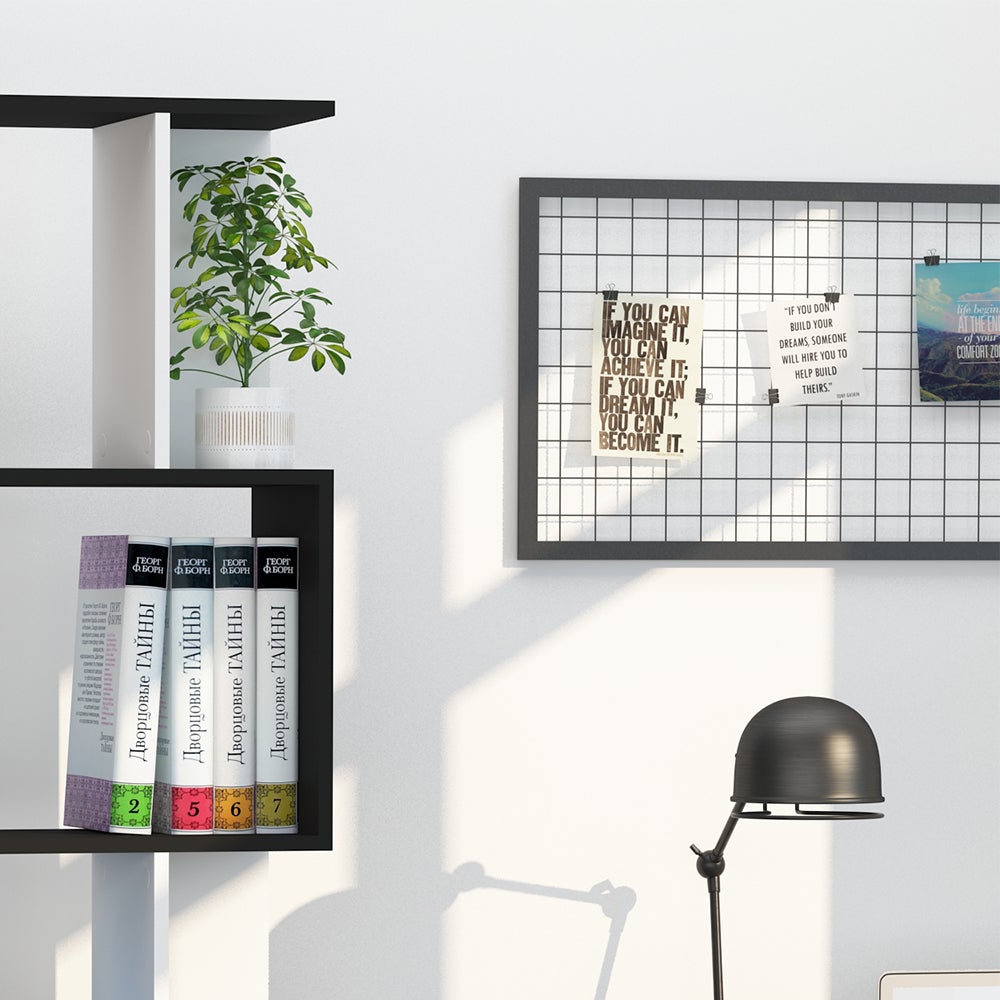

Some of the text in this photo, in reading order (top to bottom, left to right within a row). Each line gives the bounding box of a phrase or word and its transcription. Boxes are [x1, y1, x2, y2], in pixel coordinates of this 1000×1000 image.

[602, 301, 689, 324] IF YOU CAN
[797, 304, 812, 315] YOU
[957, 304, 971, 315] life
[790, 318, 833, 332] BUILD YOUR
[957, 315, 985, 333] AT THE
[602, 320, 689, 345] IMAGINE IT,
[964, 333, 997, 345] of your
[602, 338, 668, 360] YOU CAN
[779, 333, 847, 349] DREAMS, SOMEONE
[781, 348, 848, 364] WILL HIRE YOU TO
[957, 345, 988, 359] COMFORT
[600, 356, 688, 381] ACHIEVE IT;
[795, 366, 837, 379] HELP BUILD
[600, 376, 685, 399] IF YOU CAN
[599, 395, 678, 419] DREAM IT,
[599, 413, 664, 434] YOU CAN
[599, 431, 684, 453] BECOME IT.
[135, 556, 162, 566] ГЕОРГ
[177, 558, 208, 567] ГЕОРГ
[222, 558, 248, 567] ГЕОРГ
[266, 557, 292, 566] ГЕОРГ
[129, 603, 155, 762] Дворцовые ТАЙНЫ
[178, 605, 207, 763] Дворцовые ТАЙНЫ
[224, 604, 247, 765] Дворцовые ТАЙНЫ
[267, 605, 289, 760] Дворцовые ТАЙНЫ
[129, 799, 139, 814] 2
[187, 801, 200, 817] 5
[230, 802, 242, 817] 6
[273, 798, 282, 813] 7
